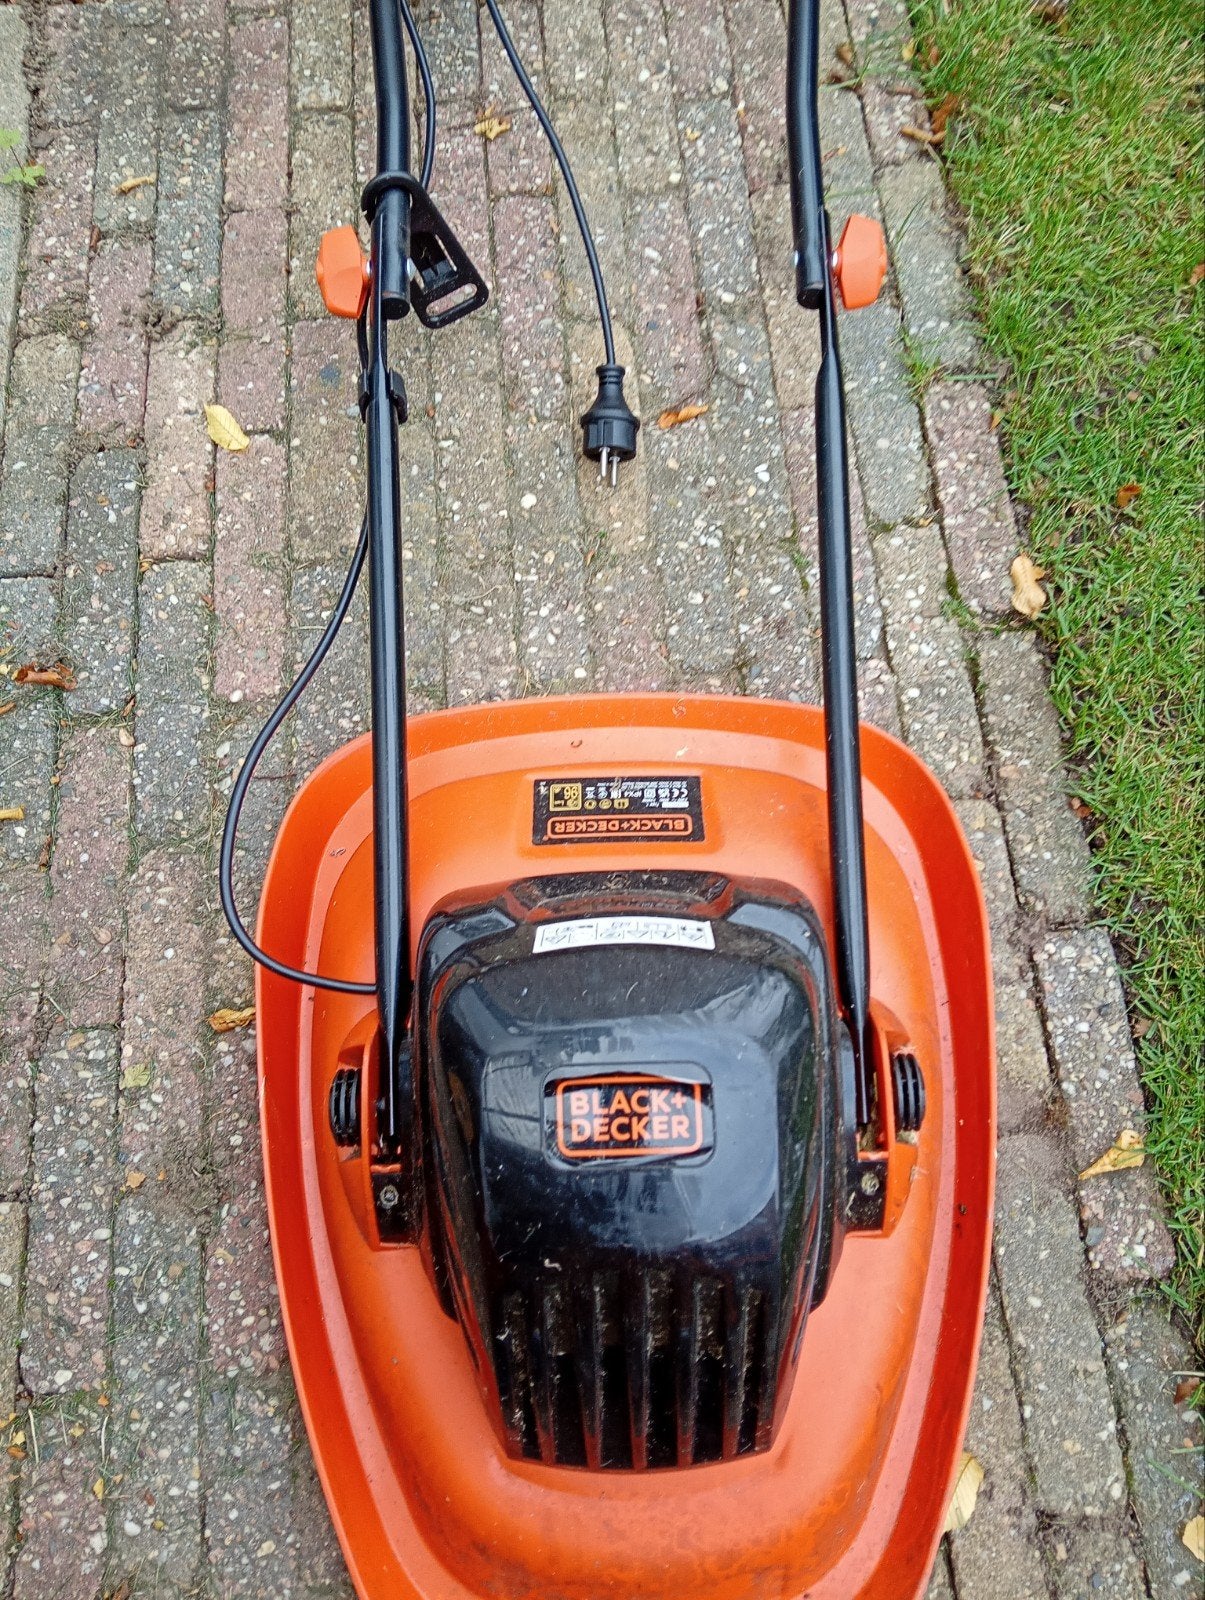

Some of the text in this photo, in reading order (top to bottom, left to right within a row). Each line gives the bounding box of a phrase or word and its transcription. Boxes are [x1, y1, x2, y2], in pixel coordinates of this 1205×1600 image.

[555, 819, 685, 833] BLACK+DECKER
[569, 1088, 688, 1116] BLACK+
[570, 1114, 690, 1143] DECKER
